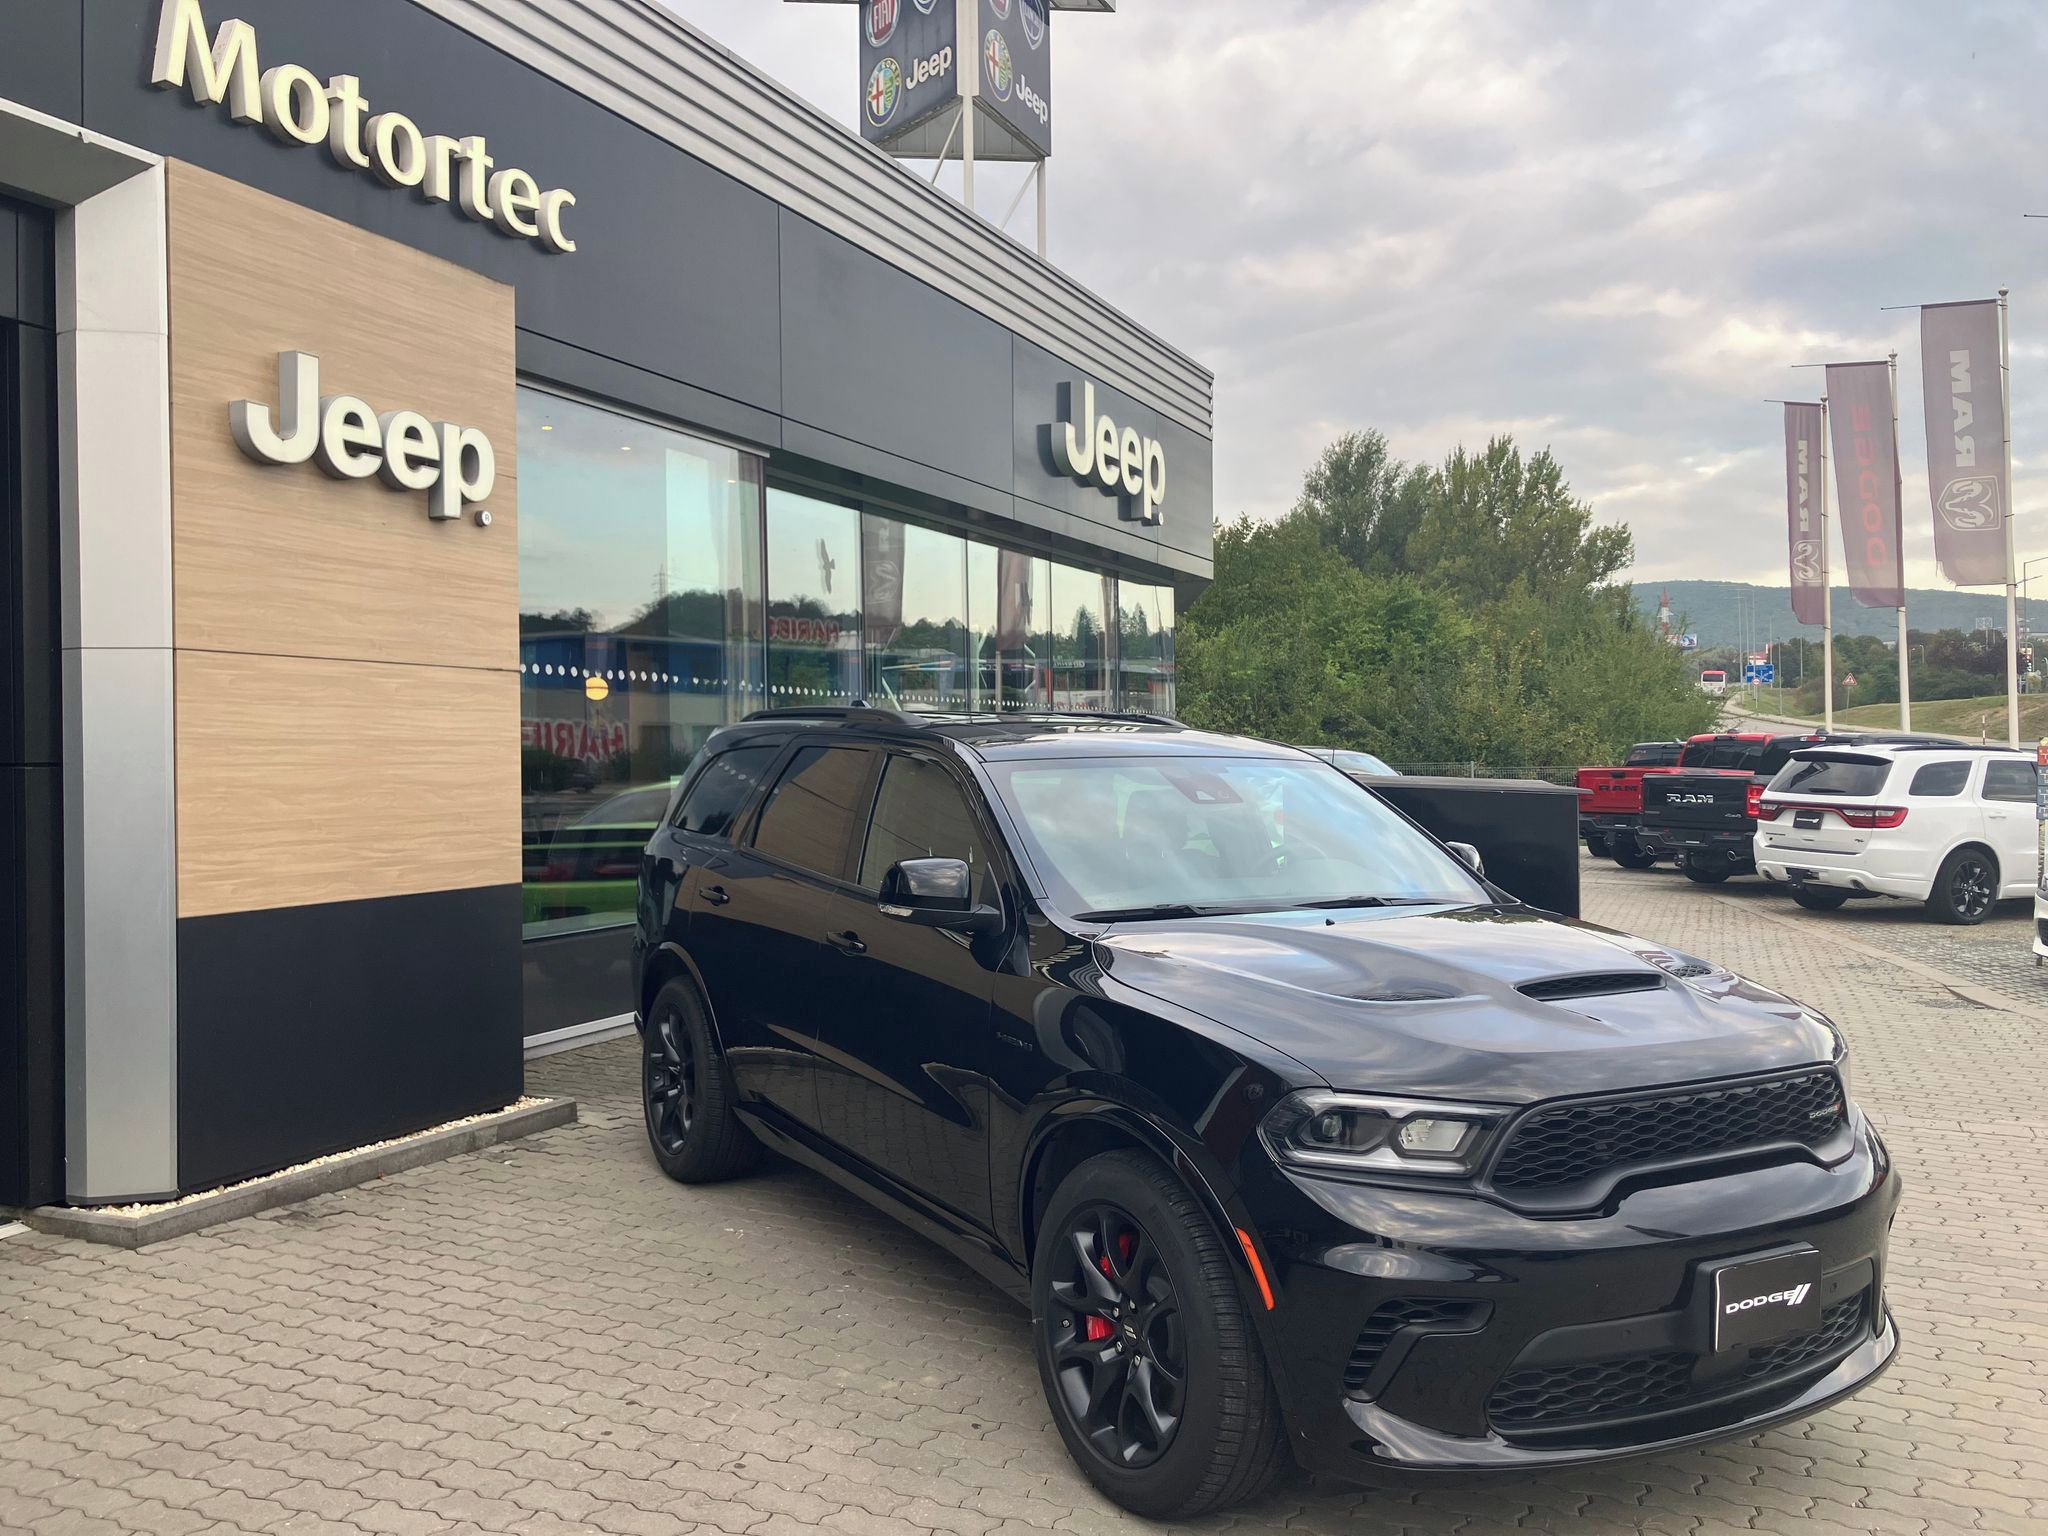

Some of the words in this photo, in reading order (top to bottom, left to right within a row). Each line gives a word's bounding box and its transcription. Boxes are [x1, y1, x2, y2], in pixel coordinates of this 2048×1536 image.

[906, 46, 952, 90] Jeep
[1015, 74, 1048, 125] Jeep
[151, 0, 576, 253] Motortec
[228, 350, 496, 520] Jeep
[1051, 380, 1166, 521] Jeep
[1599, 784, 1639, 792] RAM
[1666, 793, 1714, 804] RAM
[1725, 1289, 1798, 1314] DODGE
